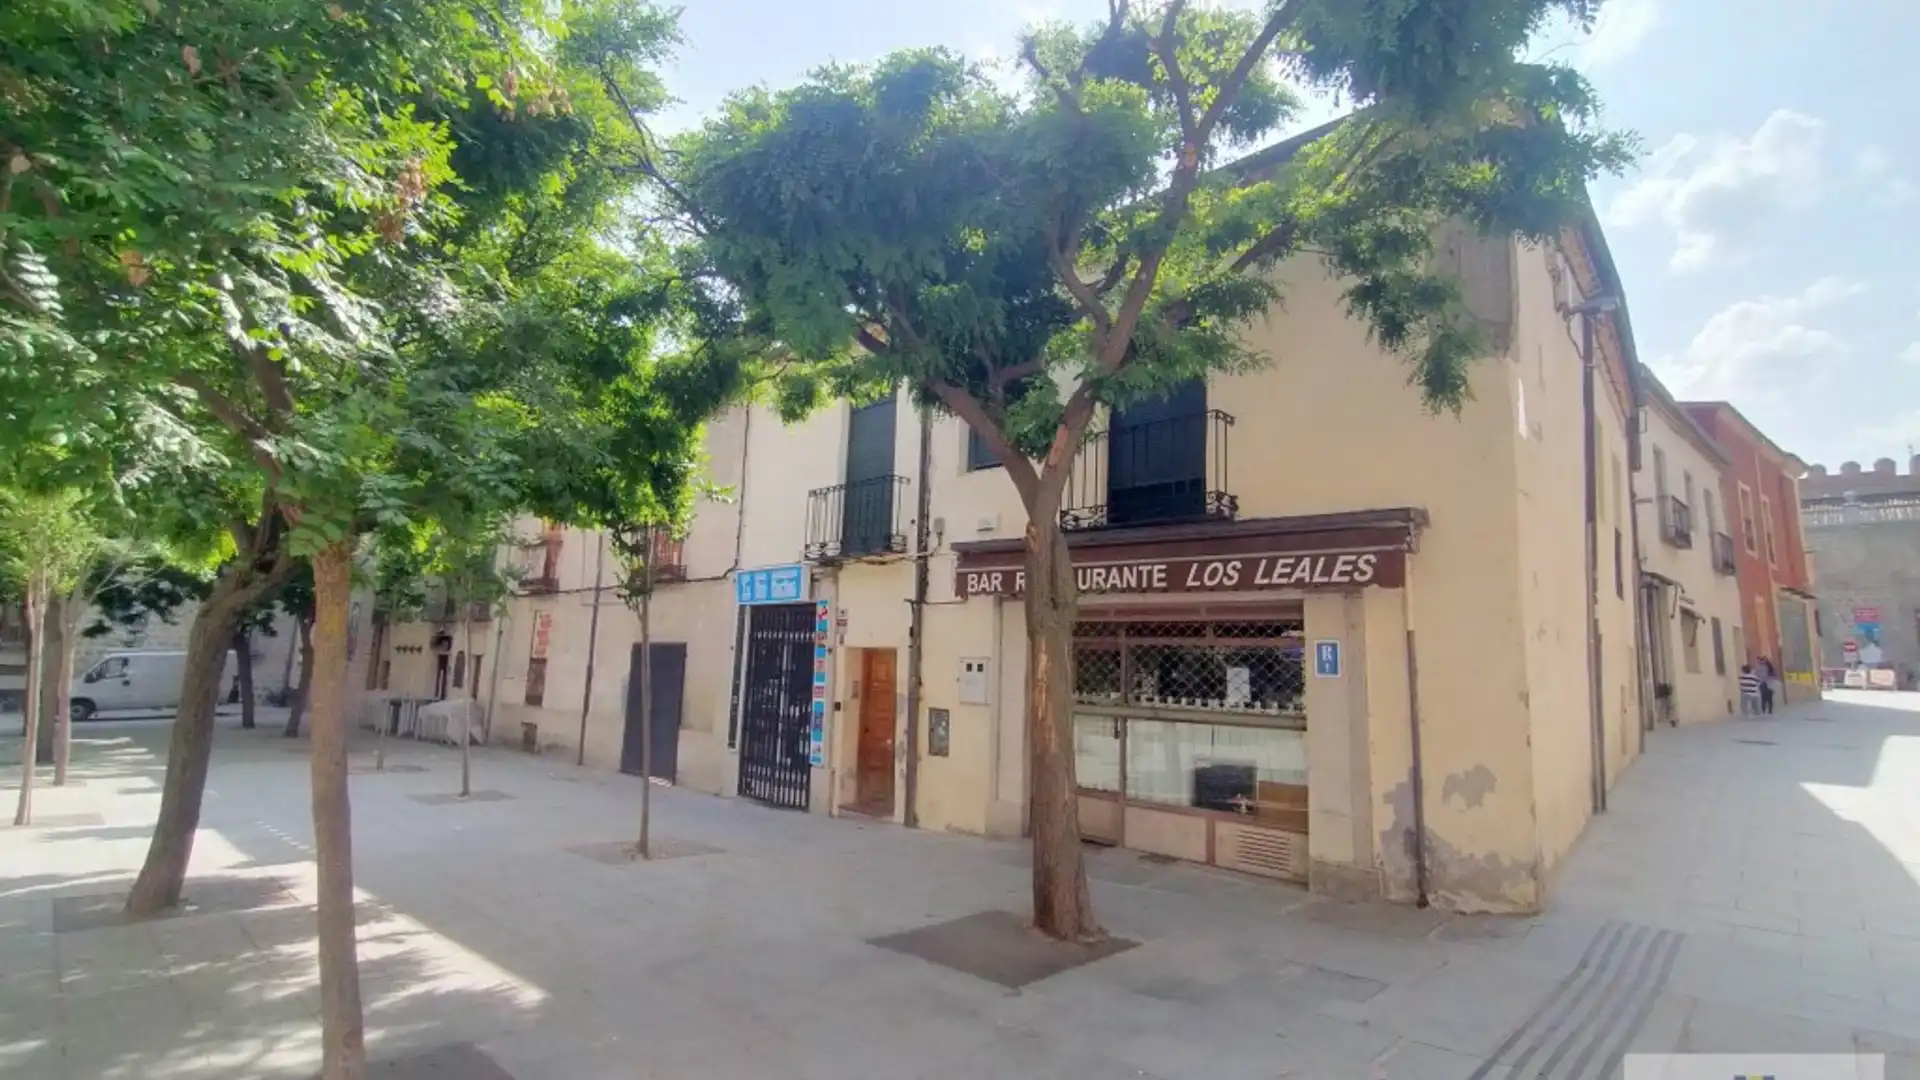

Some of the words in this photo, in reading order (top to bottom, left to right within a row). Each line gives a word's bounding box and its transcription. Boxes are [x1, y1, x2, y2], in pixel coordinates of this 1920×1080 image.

[967, 571, 1002, 592] BAR
[1015, 564, 1167, 591] RURANTE
[1186, 560, 1242, 587] LOS
[1254, 553, 1377, 584] LEALES
[1321, 645, 1333, 661] R
